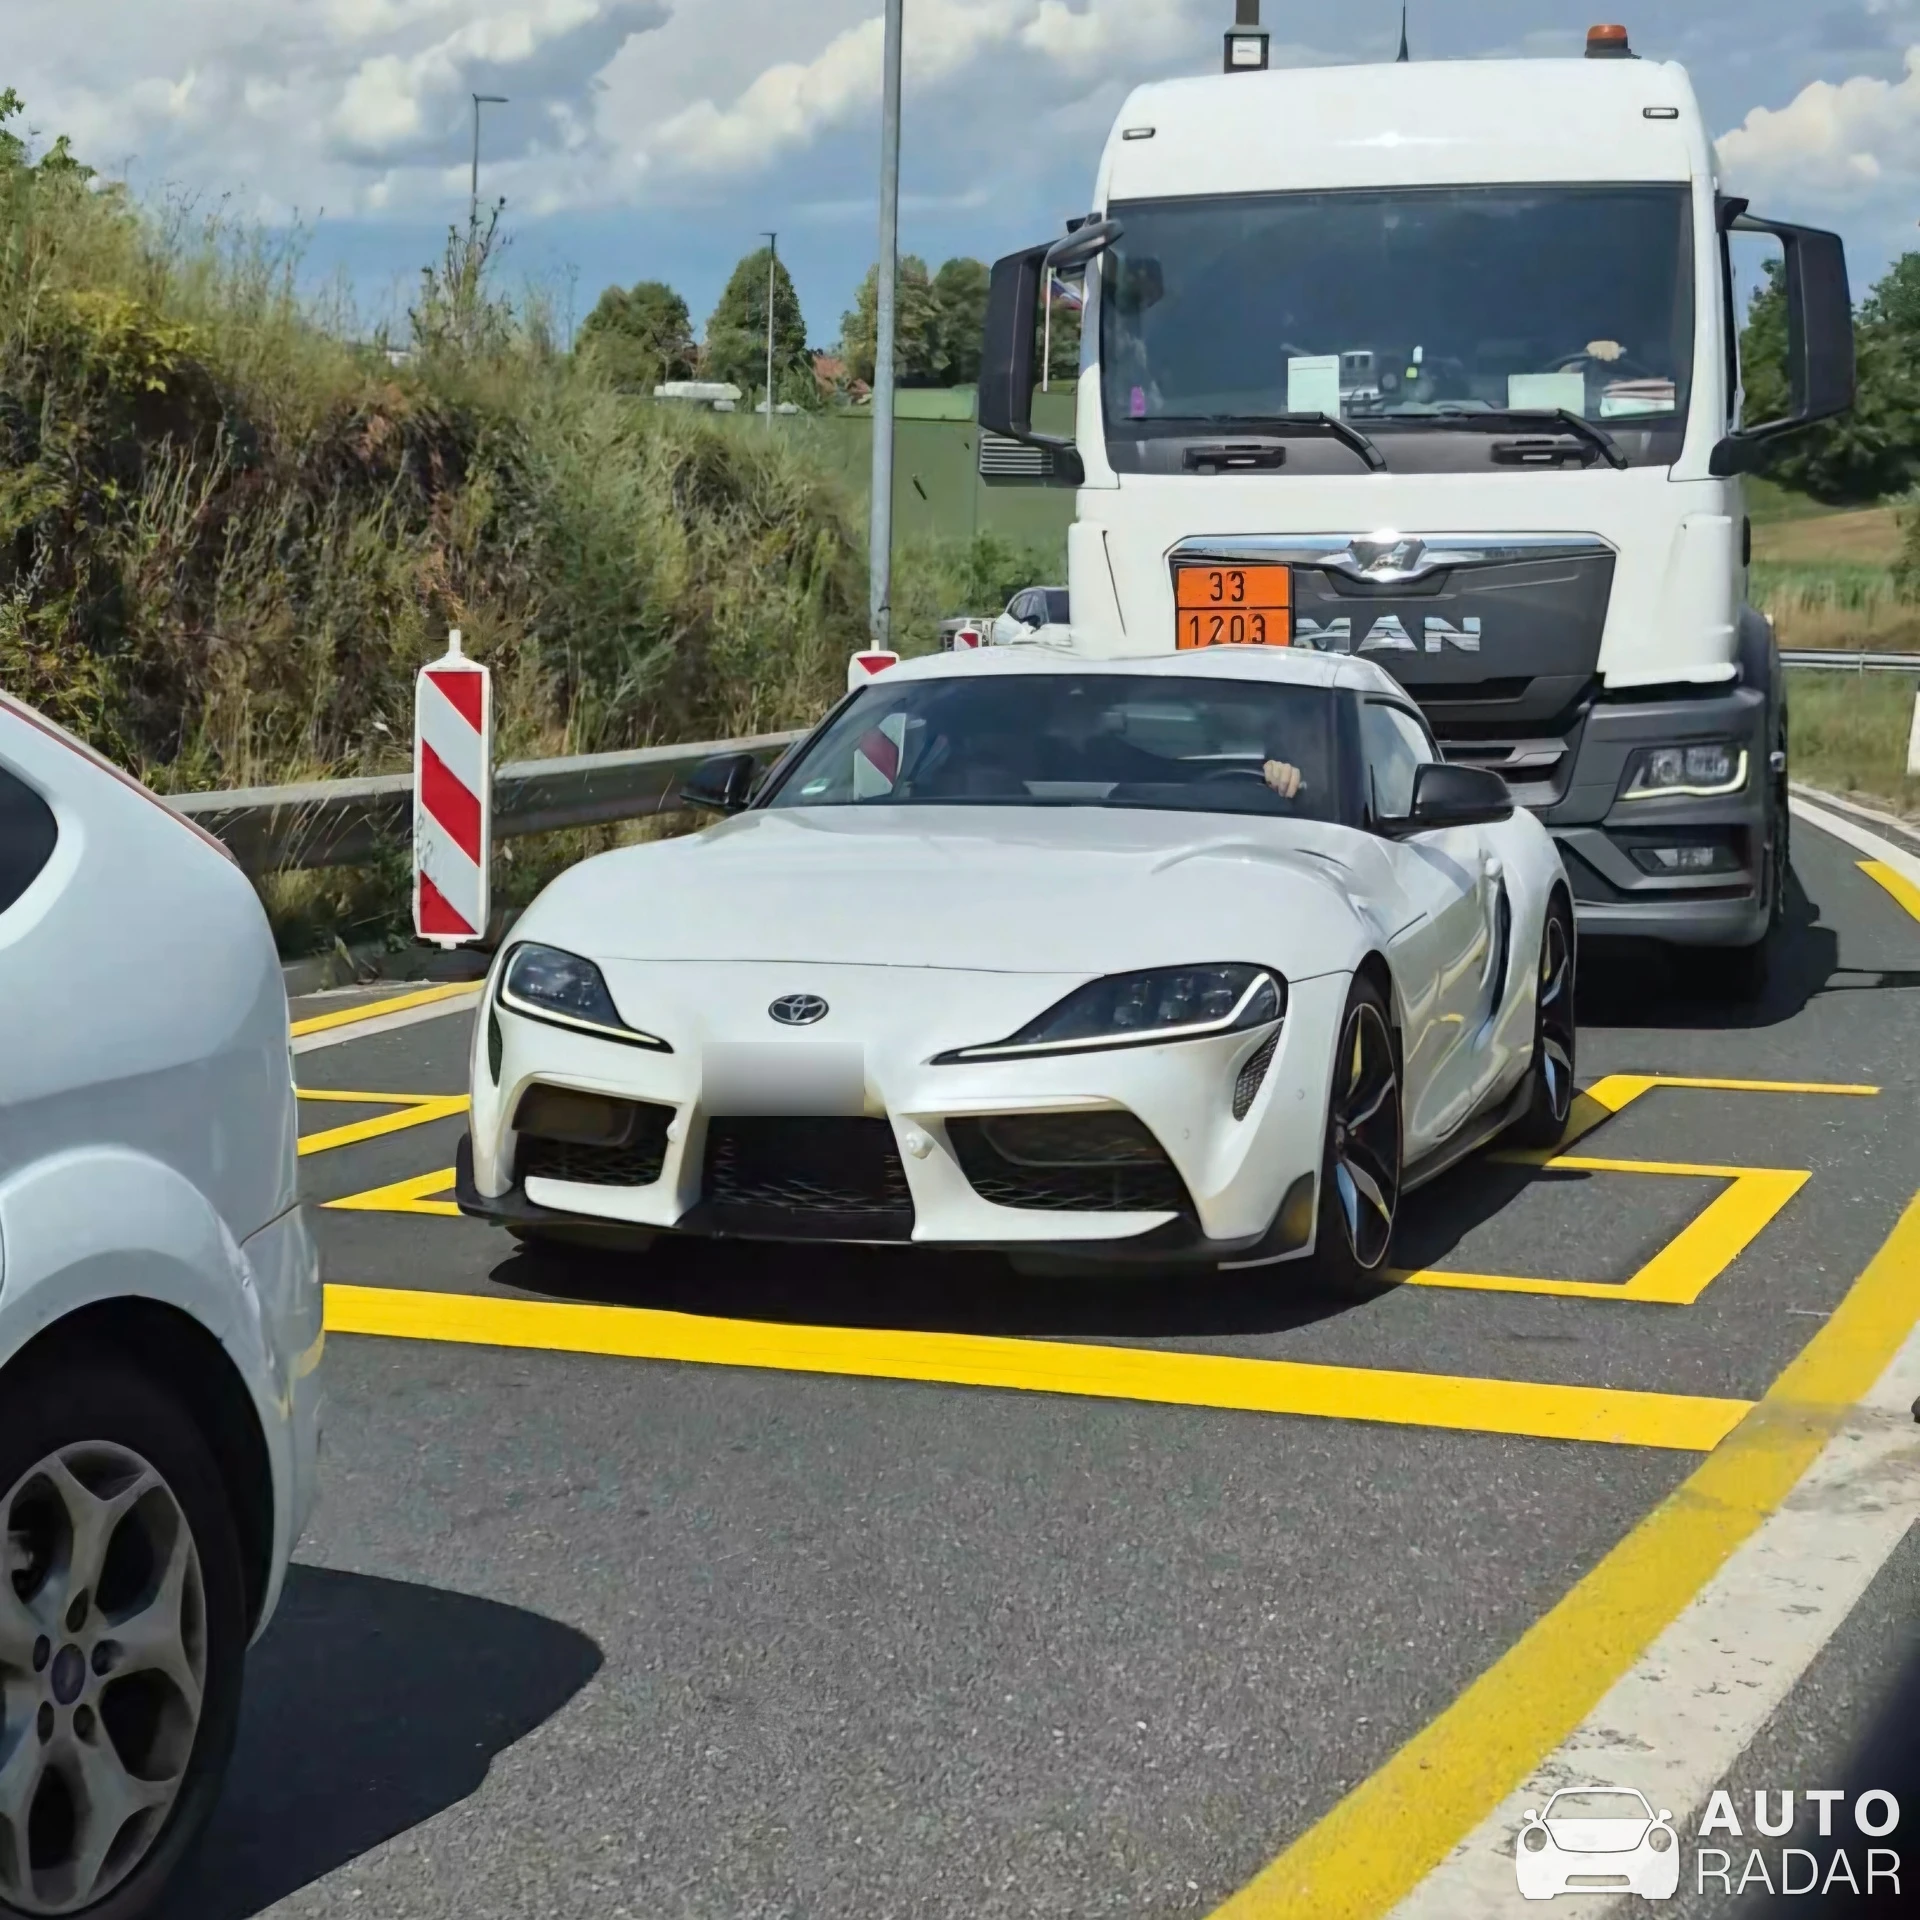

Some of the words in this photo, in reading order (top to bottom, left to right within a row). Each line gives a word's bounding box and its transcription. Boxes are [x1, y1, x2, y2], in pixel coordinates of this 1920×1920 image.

[1209, 571, 1246, 601] 33
[1190, 614, 1266, 646] 1203
[1295, 614, 1482, 652] MAN
